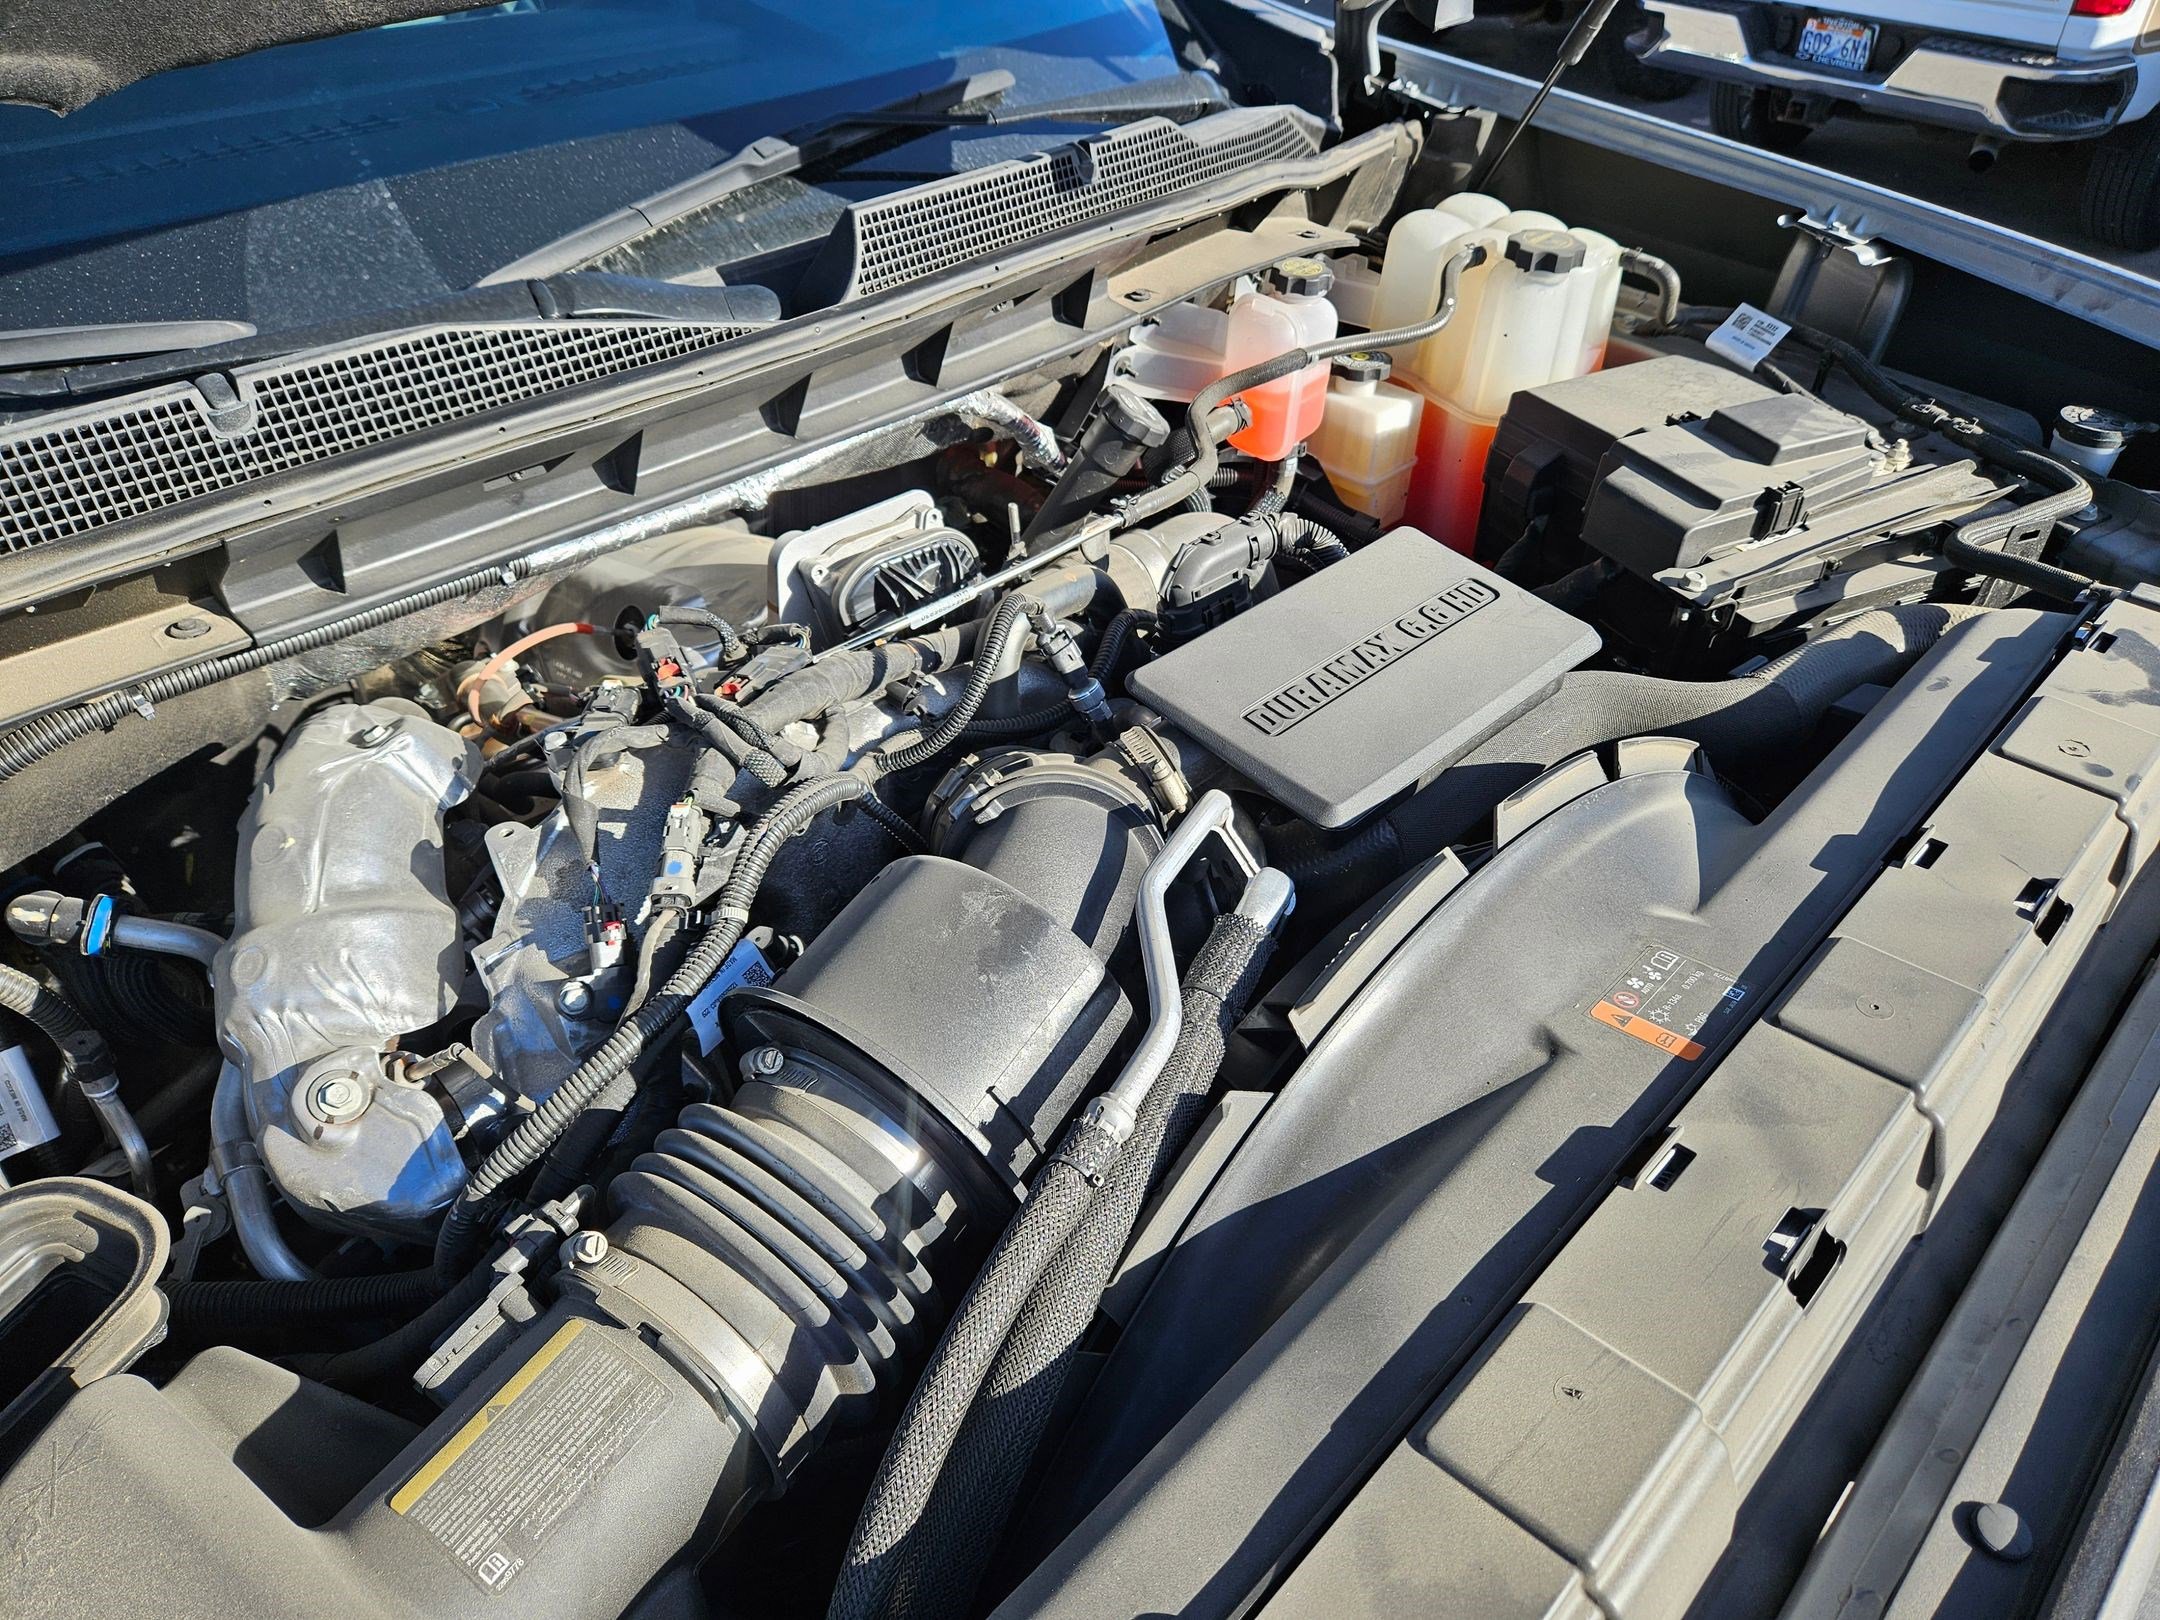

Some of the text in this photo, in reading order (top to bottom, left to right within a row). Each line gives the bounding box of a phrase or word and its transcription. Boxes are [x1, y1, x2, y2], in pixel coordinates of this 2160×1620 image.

[1802, 31, 1868, 60] G09 6NA
[1242, 582, 1497, 735] DURAMAX 6.6 HD
[17, 1108, 28, 1122] MADE
